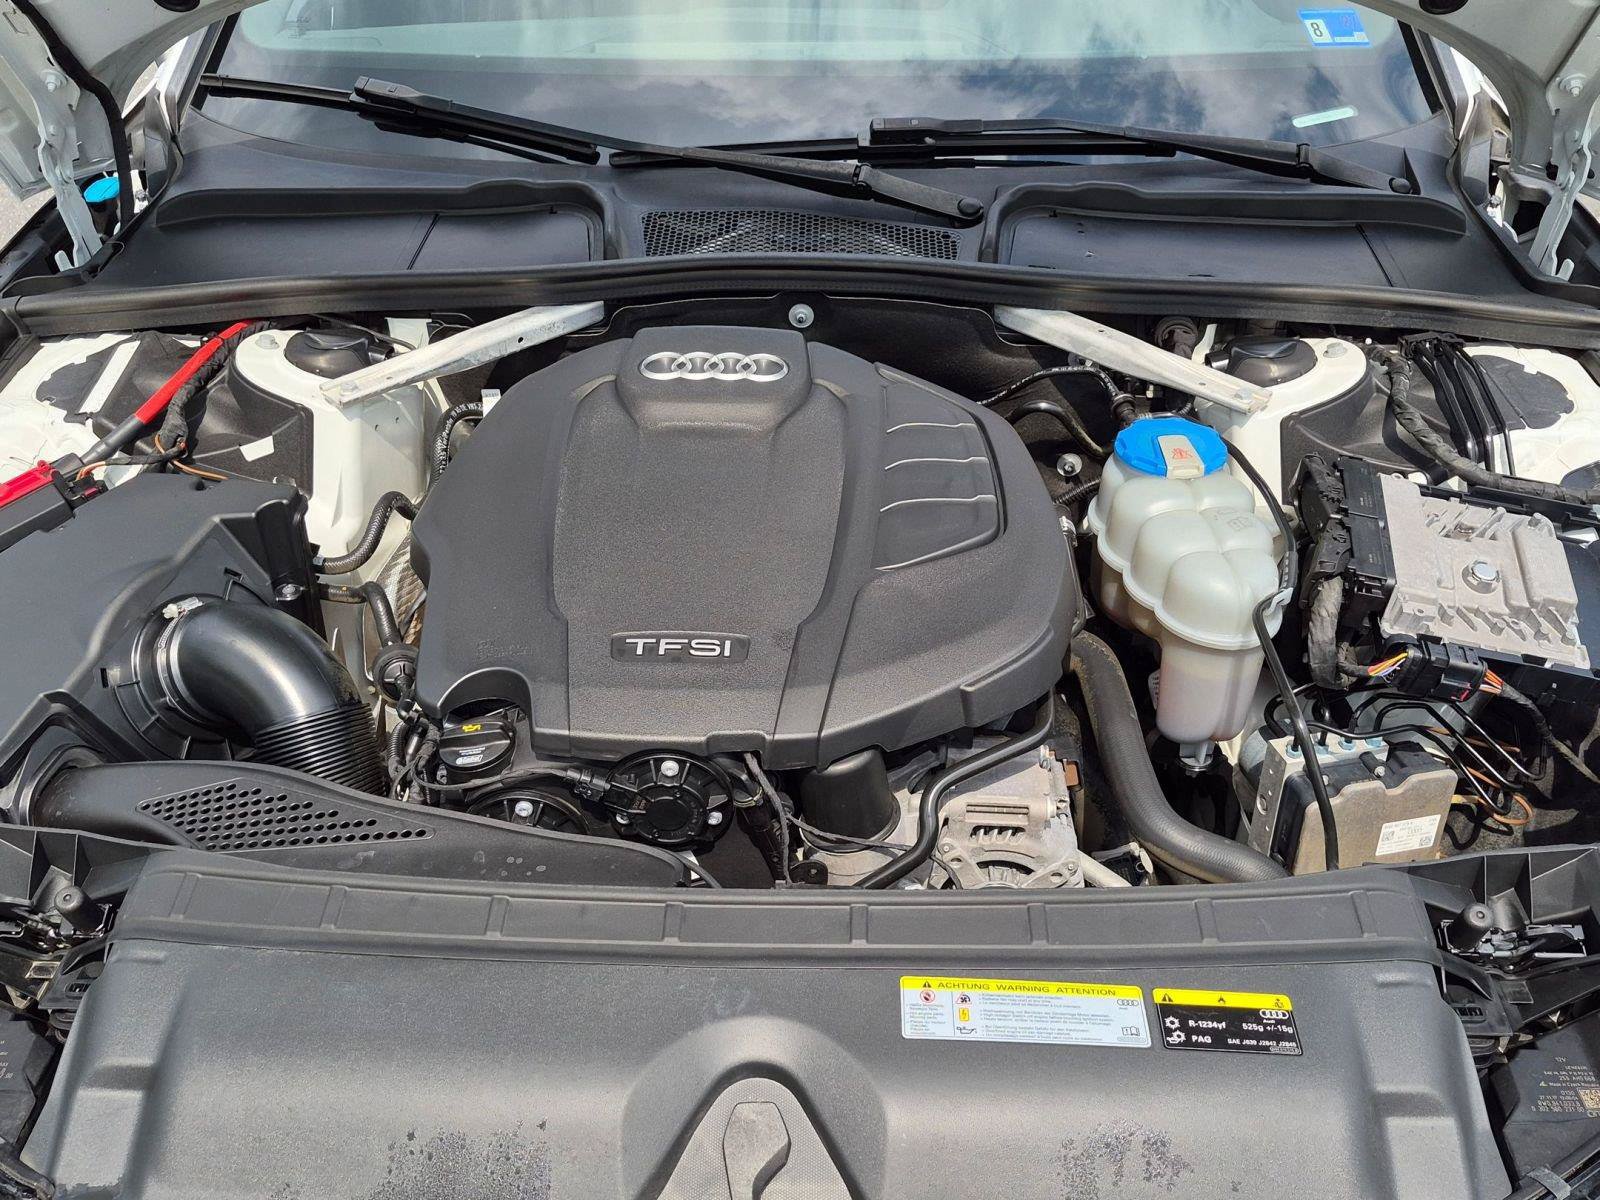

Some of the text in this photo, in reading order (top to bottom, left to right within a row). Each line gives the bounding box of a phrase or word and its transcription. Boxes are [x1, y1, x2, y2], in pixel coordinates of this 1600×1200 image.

[1311, 22, 1323, 37] 8
[626, 638, 732, 657] TFSI
[937, 981, 990, 990] ACHTUNG
[996, 984, 1050, 993] WARNING
[1056, 987, 1116, 997] ATTENTION
[1188, 1020, 1293, 1034] R-1234yf 525g +/-15g
[1192, 1035, 1212, 1043] PAG
